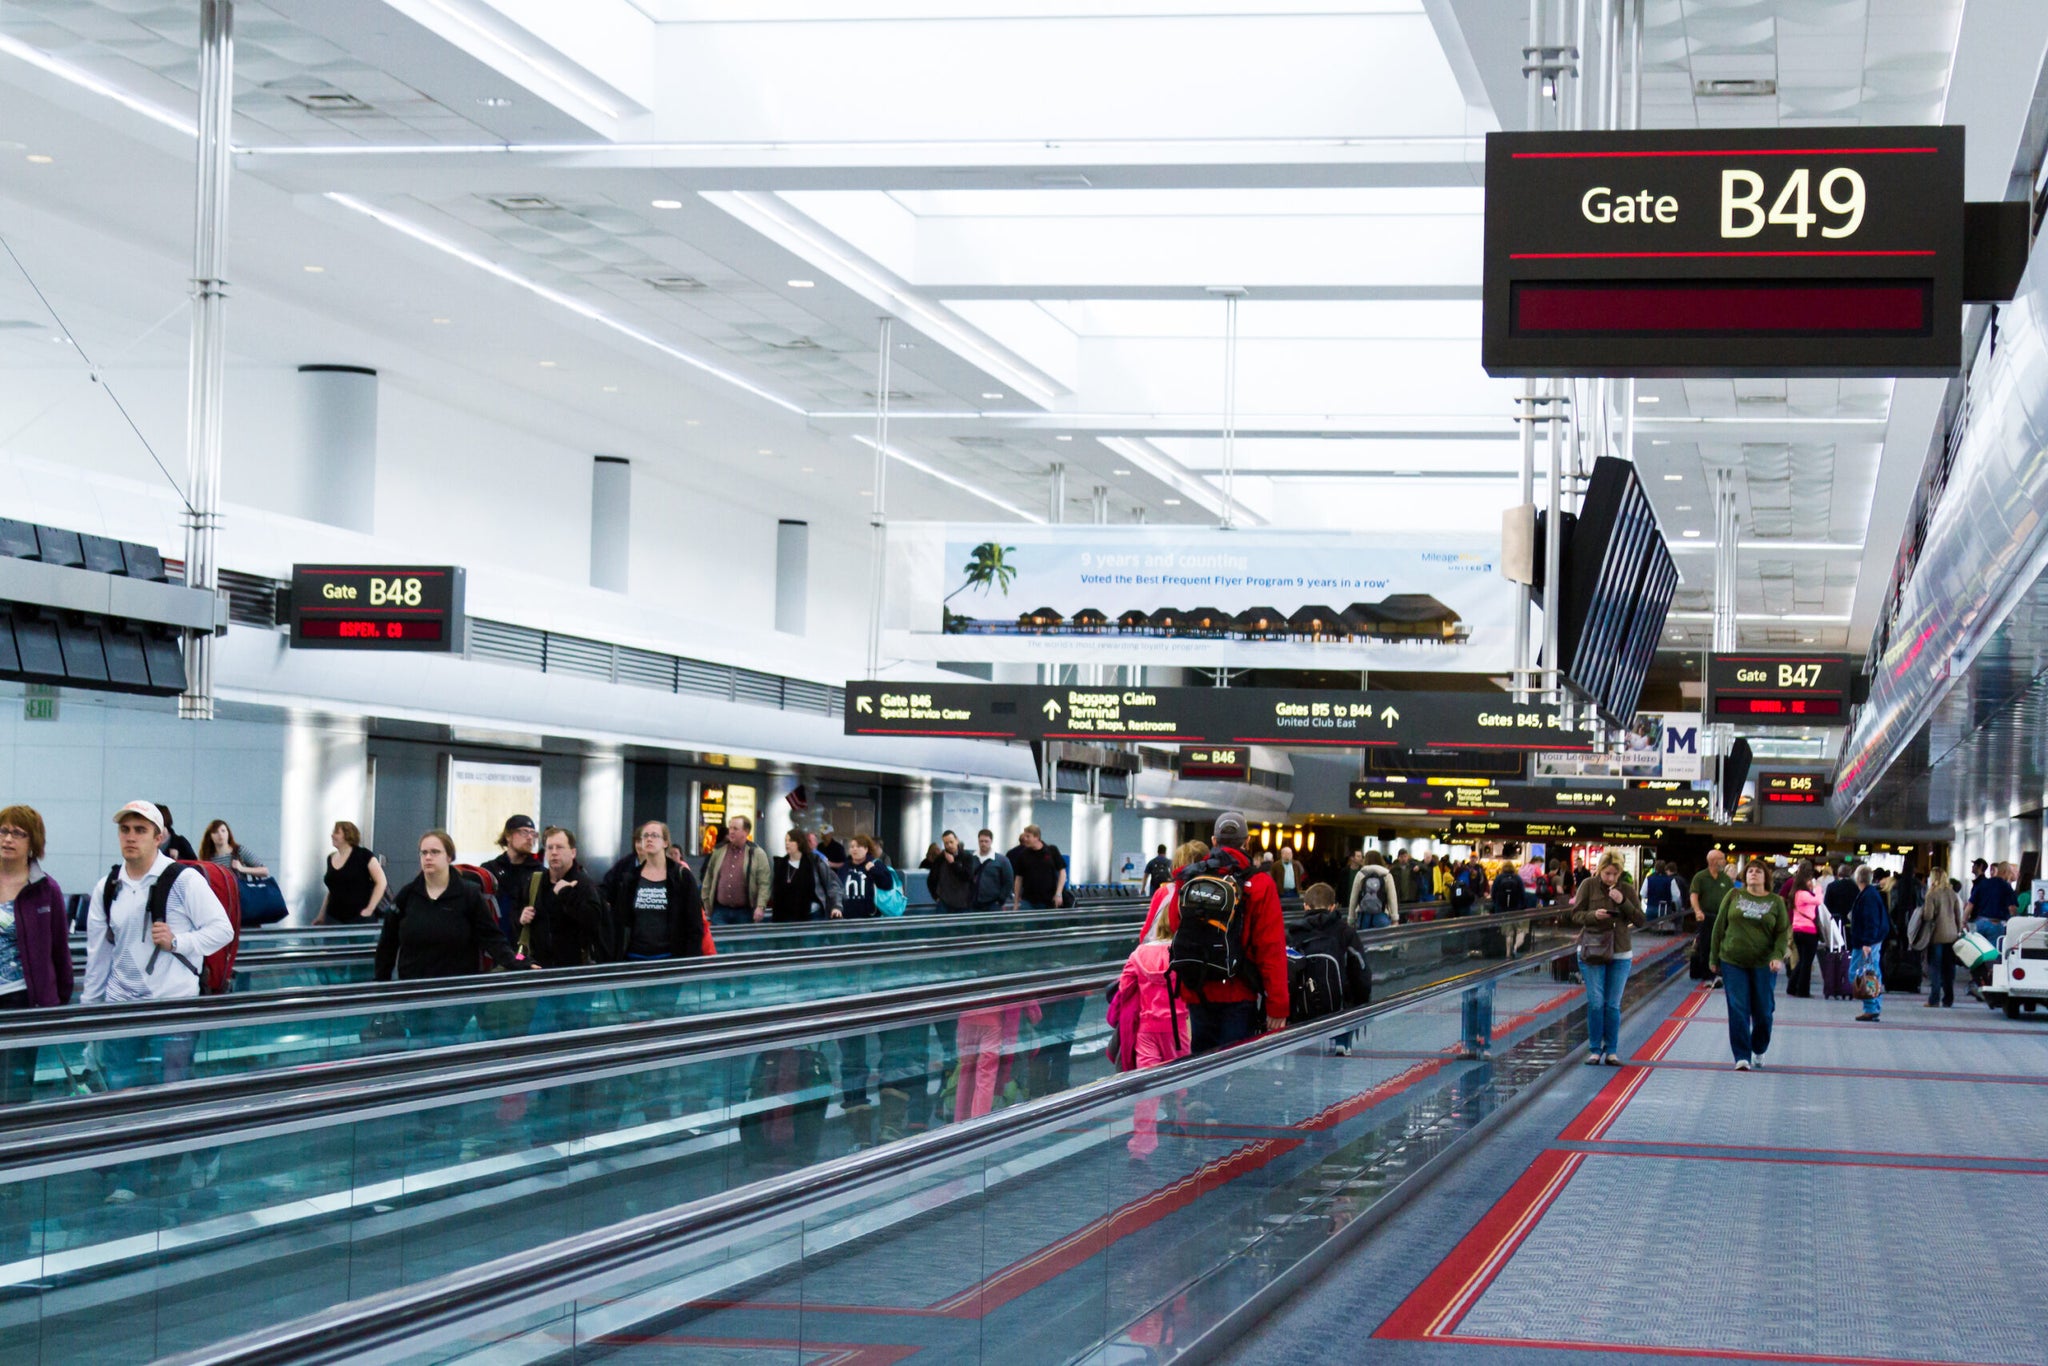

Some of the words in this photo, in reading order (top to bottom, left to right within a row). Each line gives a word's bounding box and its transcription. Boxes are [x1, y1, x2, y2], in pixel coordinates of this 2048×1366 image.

[1581, 187, 1679, 224] Gate
[1721, 167, 1866, 238] B49
[1080, 552, 1091, 567] 9
[1096, 554, 1139, 569] years
[1145, 553, 1174, 567] and
[1179, 553, 1248, 570] counting
[1081, 574, 1111, 584] Voted
[1115, 574, 1132, 584] the
[1136, 575, 1159, 585] Best
[1162, 575, 1211, 586] Frequent
[1214, 576, 1243, 587] Flyer
[1246, 576, 1293, 588] Program
[1297, 577, 1303, 587] 9
[1307, 578, 1337, 589] years
[1340, 577, 1351, 587] in
[1354, 579, 1361, 588] a
[322, 583, 358, 599] Gate
[370, 578, 422, 606] B48
[1737, 669, 1767, 682] Gate
[1778, 664, 1822, 687] B47
[880, 693, 908, 707] Gate
[1069, 691, 1120, 707] Baggage
[1123, 692, 1156, 706] Claim
[29, 699, 53, 719] EXIT
[880, 707, 909, 720] Special
[911, 708, 941, 719] Service
[942, 709, 971, 720] Center
[1069, 705, 1120, 719] Terminal
[1275, 702, 1309, 716] Gates
[1333, 704, 1347, 717] to
[1350, 704, 1372, 717] B44
[1068, 719, 1094, 731] Food,
[1096, 720, 1126, 732] Shops,
[1128, 720, 1176, 732] Restrooms
[1277, 717, 1309, 727] United
[1312, 717, 1334, 727] Club
[1337, 718, 1357, 728] East
[1478, 712, 1513, 726] Gates
[1517, 713, 1543, 729] B45,
[1667, 726, 1697, 754] M
[1191, 752, 1208, 761] Gate
[1212, 750, 1236, 764] B46
[1542, 753, 1563, 762] Your
[1566, 753, 1600, 763] Legacy
[1633, 753, 1657, 763] Here
[1771, 778, 1786, 787] Gate
[1790, 777, 1812, 790] B45
[1368, 790, 1383, 798] Gate
[1556, 792, 1573, 801] Gates
[1666, 797, 1682, 807] Gate
